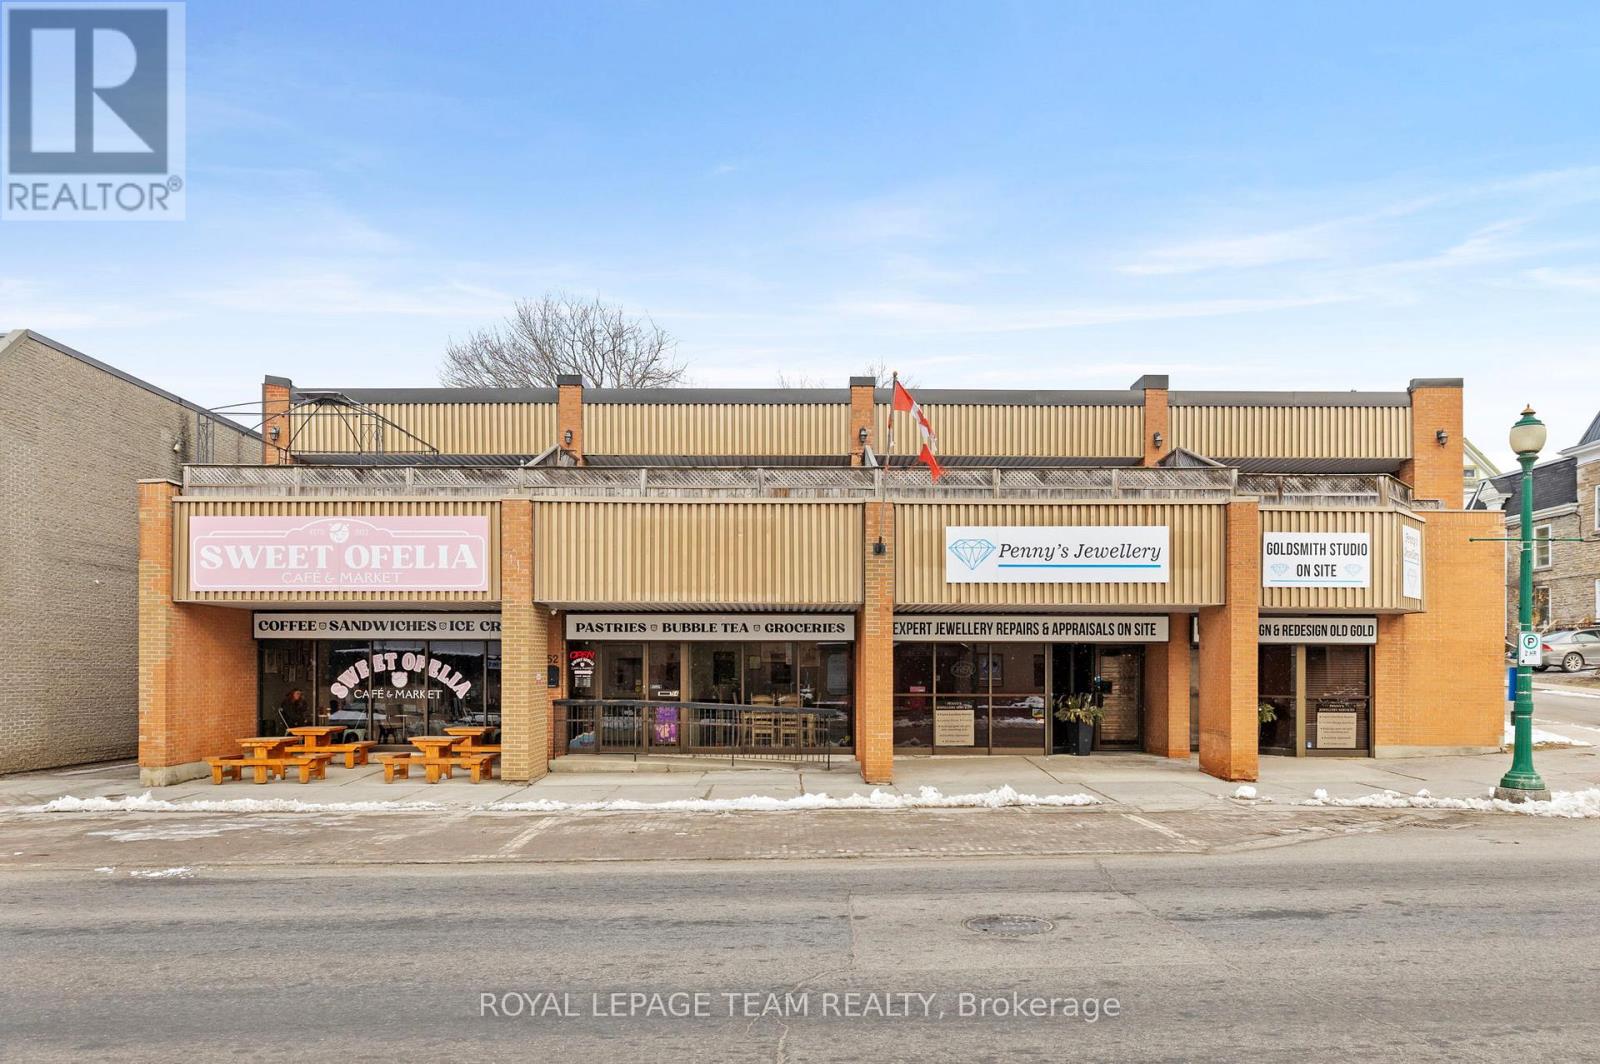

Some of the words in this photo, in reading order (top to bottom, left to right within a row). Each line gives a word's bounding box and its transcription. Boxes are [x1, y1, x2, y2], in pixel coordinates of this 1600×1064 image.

[998, 543, 1069, 562] Penny's
[1074, 543, 1161, 562] Jewellery
[1266, 542, 1327, 556] GOLDSMITH
[1329, 542, 1368, 556] STUDIO
[199, 544, 334, 569] SWEET
[344, 544, 478, 569] OFELIA
[340, 572, 402, 584] MARKET
[1296, 564, 1311, 578] ON
[1313, 564, 1337, 578] SITE
[258, 619, 317, 632] COFFEE
[329, 619, 437, 632] SANDWICHES
[450, 620, 475, 632] ICE
[480, 620, 501, 632] CR
[575, 622, 647, 633] PASTRIES
[662, 622, 718, 633] BUBBLE
[721, 622, 749, 633] TEA
[764, 622, 846, 634] GROCERIES
[893, 622, 932, 635] EXPERT
[935, 622, 993, 635] JEWELLERY
[997, 622, 1039, 635] REPAIRS
[1042, 622, 1049, 635] &
[1052, 622, 1115, 636] APPRAISALS
[1117, 623, 1131, 636] ON
[1134, 623, 1157, 636] SITE
[1273, 624, 1280, 636] &
[1282, 624, 1328, 637] REDESIGN
[1330, 624, 1348, 637] OLD
[1350, 624, 1374, 637] GOLD
[330, 652, 398, 699] SWEET
[401, 652, 472, 700] OFELIA
[353, 687, 384, 699] CAFÉ
[386, 690, 394, 699] &
[395, 689, 443, 699] MARKET
